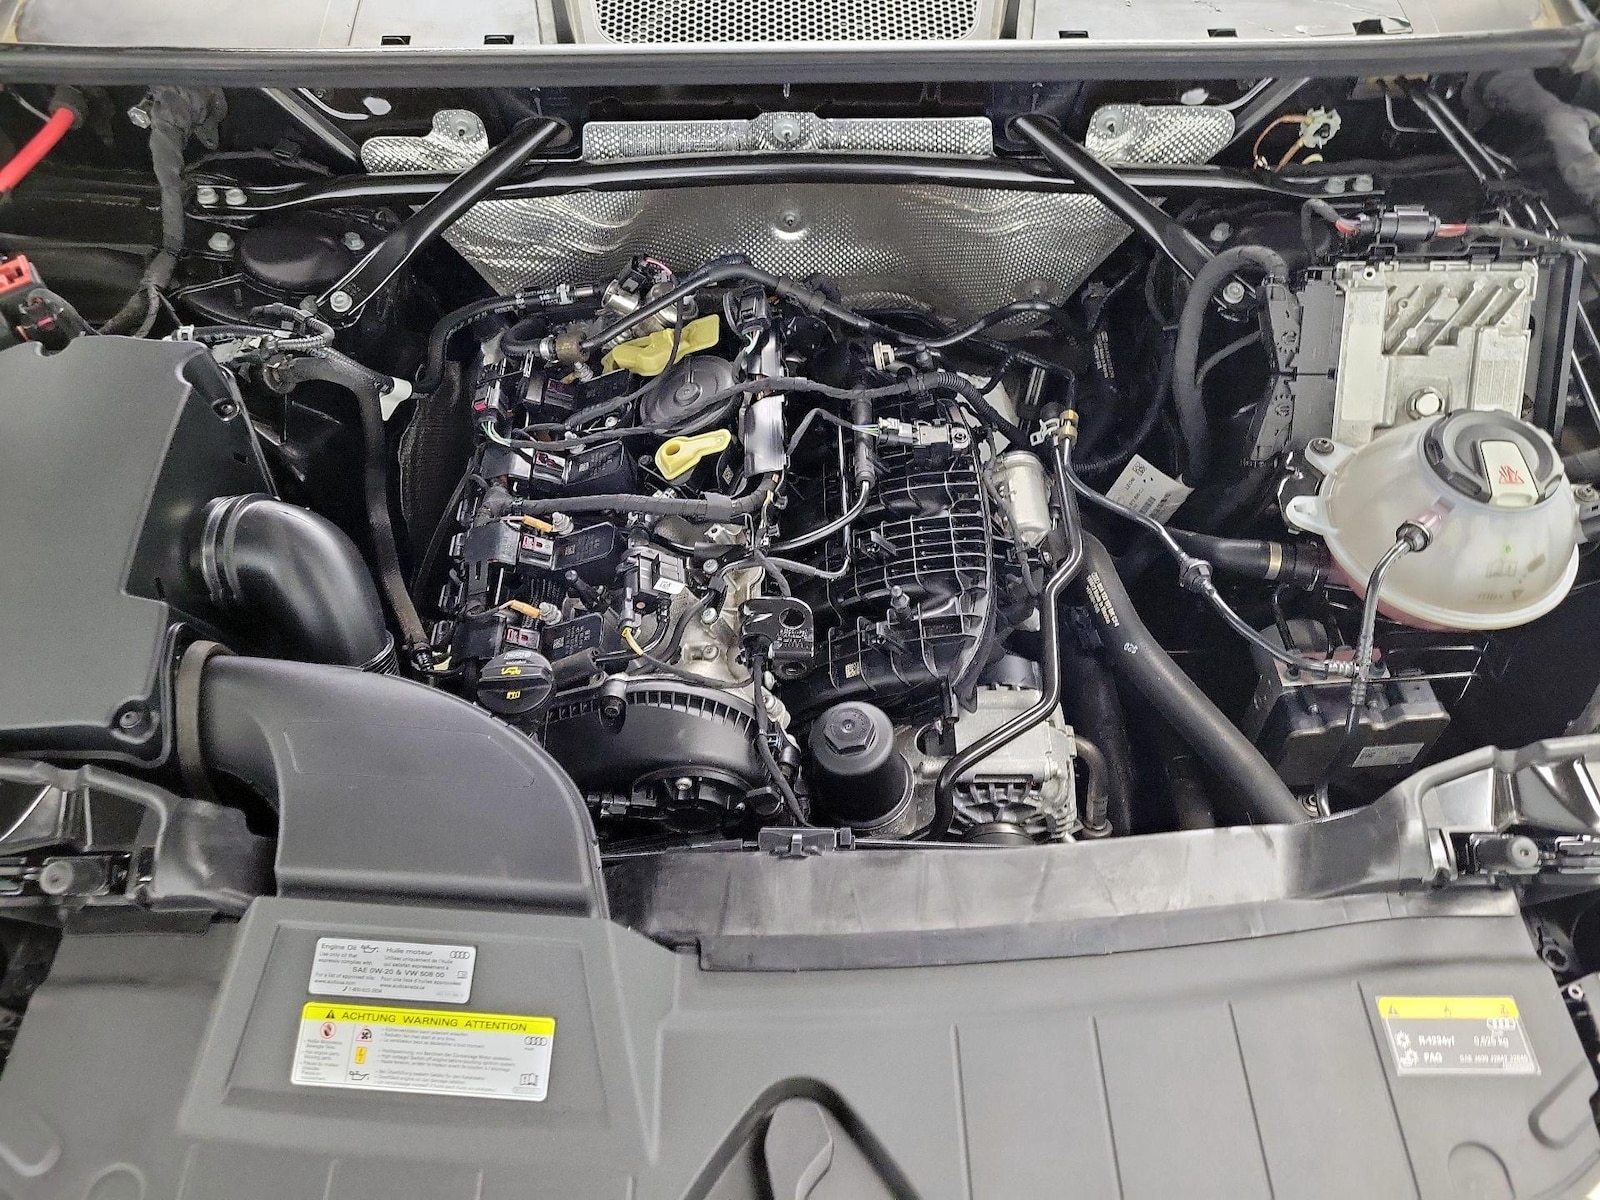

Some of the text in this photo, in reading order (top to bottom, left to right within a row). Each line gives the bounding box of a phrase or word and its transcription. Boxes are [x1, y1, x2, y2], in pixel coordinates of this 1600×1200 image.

[342, 1012, 527, 1031] ACHTUNG WARNING ATTENTION
